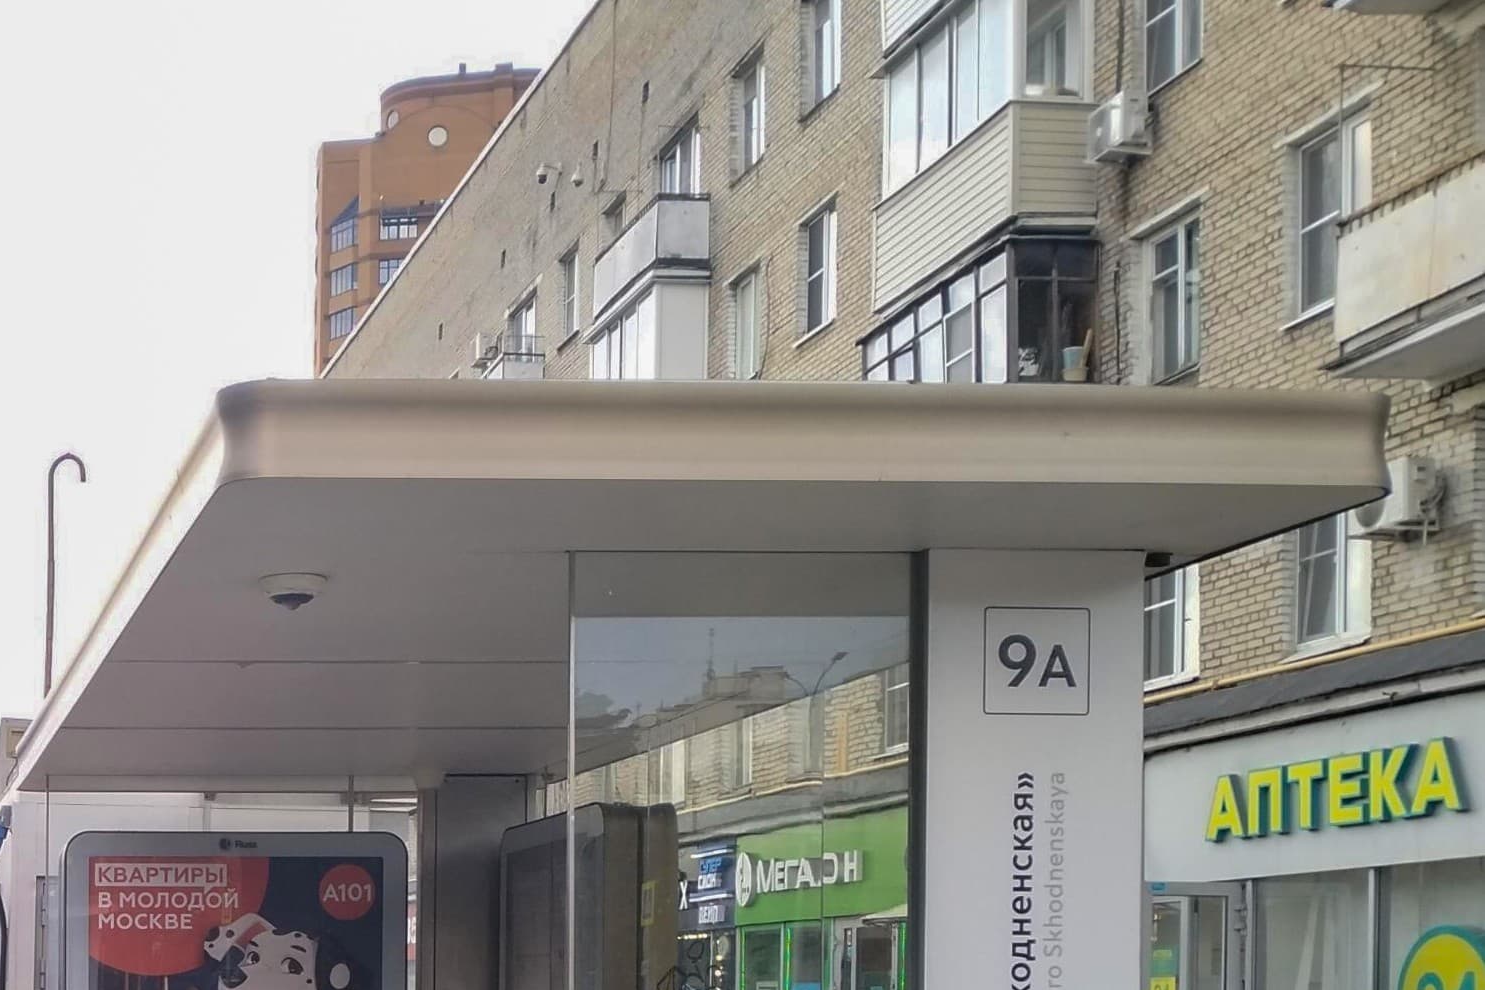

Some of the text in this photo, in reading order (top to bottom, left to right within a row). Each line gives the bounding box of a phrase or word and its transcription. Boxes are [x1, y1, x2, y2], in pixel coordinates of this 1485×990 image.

[1205, 736, 1471, 842] АПТЕКА
[97, 866, 224, 883] КВАРТИРЫ
[1043, 772, 1069, 957] Skhodnenskaya
[98, 888, 239, 911] В МОЛОДОЙ
[98, 913, 193, 930] МОСКВЕ
